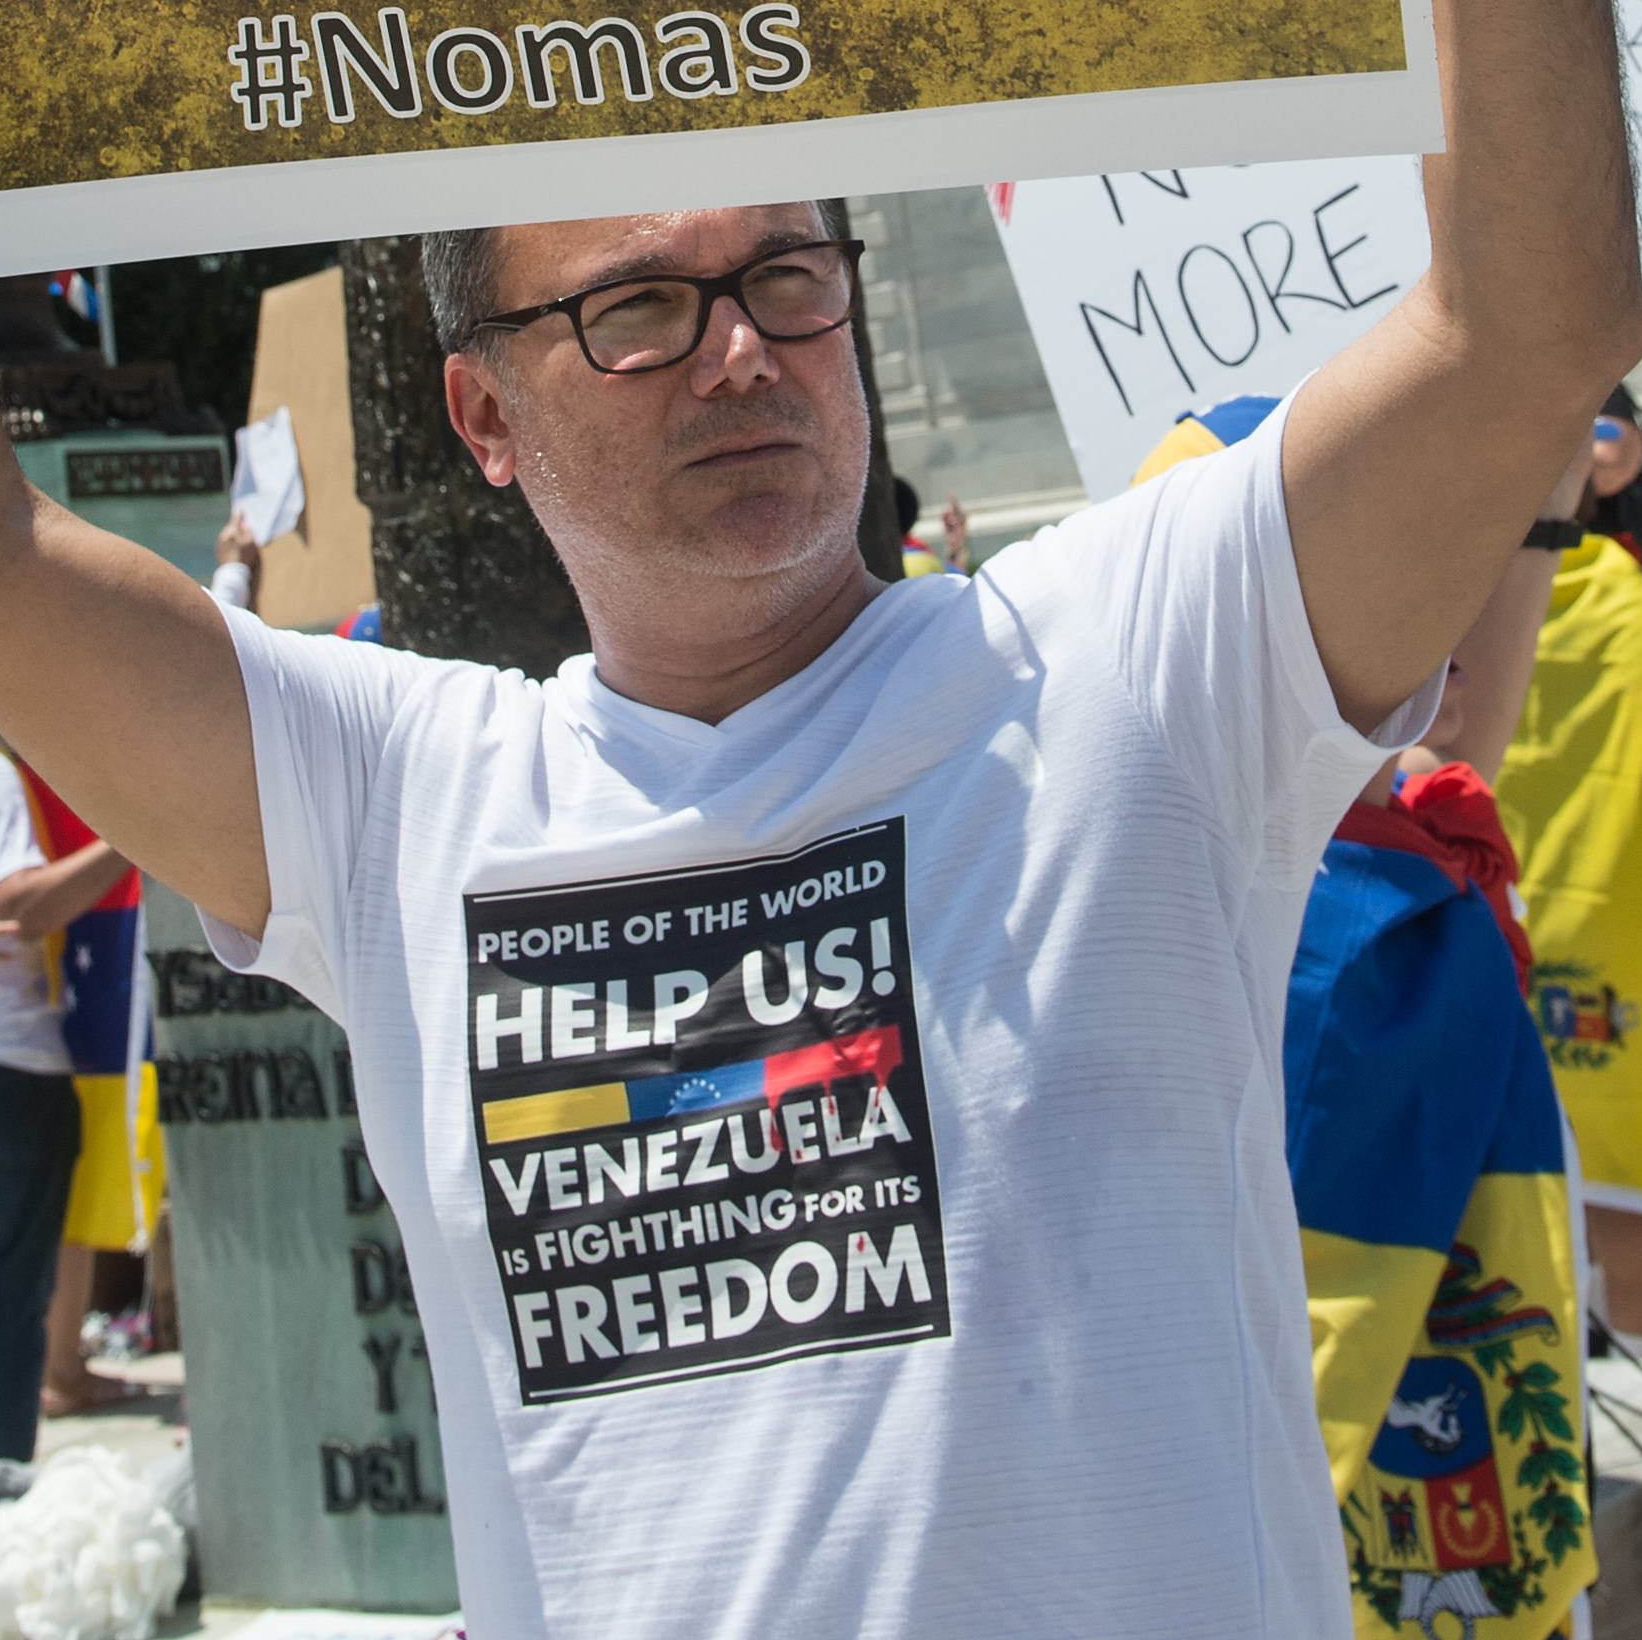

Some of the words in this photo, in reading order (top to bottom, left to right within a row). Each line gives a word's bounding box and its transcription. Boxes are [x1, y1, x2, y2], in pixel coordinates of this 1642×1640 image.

[232, 0, 812, 133] #Nomas
[1080, 183, 1399, 417] MORE
[478, 917, 610, 964] PEOPLE
[623, 910, 672, 945] OF
[684, 897, 749, 937] THE
[760, 859, 888, 921] WORLD
[476, 968, 710, 1071] HELP
[741, 916, 896, 1027] US!
[488, 1085, 912, 1216] VENEZUELA
[503, 1249, 530, 1276] IS
[534, 1189, 796, 1272] FIGHTHING
[803, 1184, 865, 1222] FOR
[874, 1175, 921, 1208] ITS
[513, 1223, 933, 1368] FREEDOM
